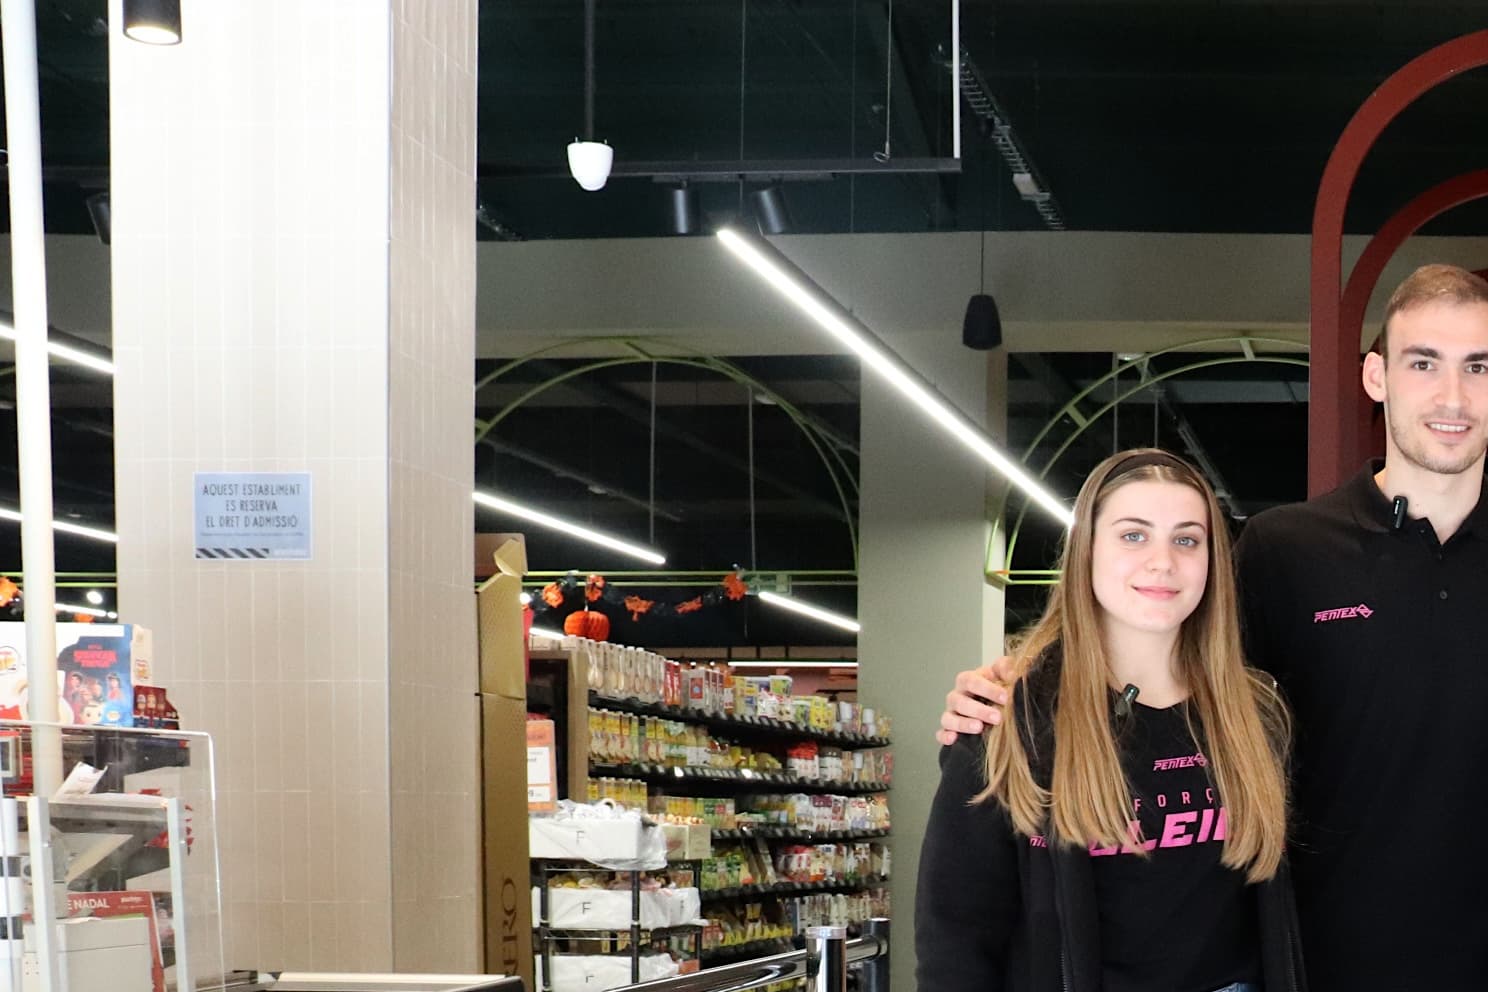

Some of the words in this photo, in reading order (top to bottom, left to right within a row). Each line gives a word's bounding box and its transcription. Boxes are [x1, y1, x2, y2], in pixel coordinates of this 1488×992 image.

[202, 484, 239, 496] AQUEST
[243, 484, 301, 495] ESTABLIMENT
[240, 500, 278, 511] RESERVA
[206, 516, 215, 527] EL
[219, 516, 240, 527] DRET
[74, 898, 111, 910] NADAL
